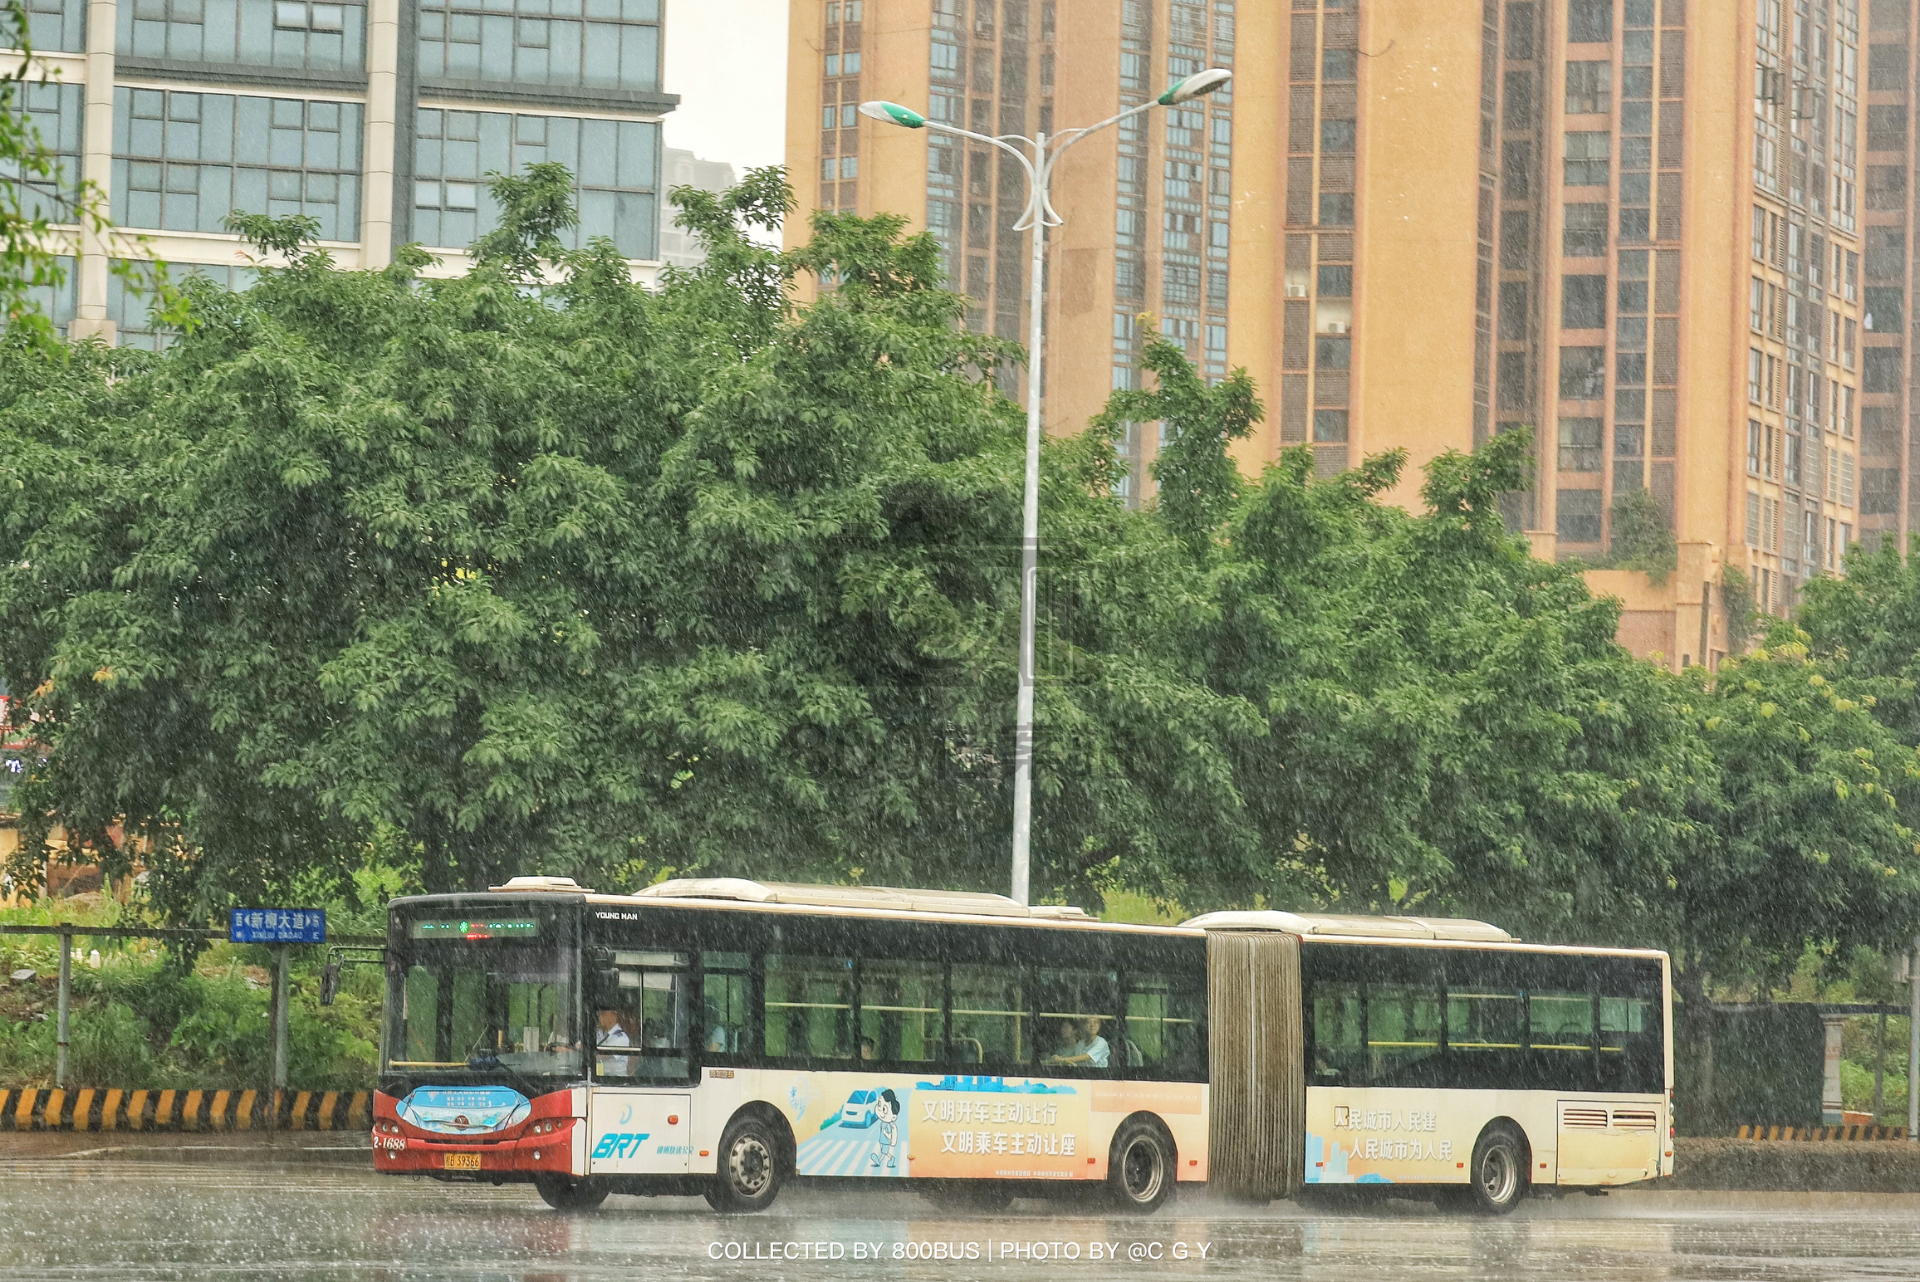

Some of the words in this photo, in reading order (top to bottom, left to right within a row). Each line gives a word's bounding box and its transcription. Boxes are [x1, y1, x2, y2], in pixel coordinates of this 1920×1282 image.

[595, 911, 620, 920] YOUNG
[621, 912, 638, 921] MAN
[922, 1099, 1058, 1126] 文明开车主动让行
[1333, 1107, 1437, 1132] 人民城市人民建
[373, 1136, 406, 1151] 2-1688
[591, 1133, 650, 1159] BRT
[940, 1129, 1077, 1156] 文明乘车主动让座
[1349, 1137, 1453, 1161] 人民城市为人民
